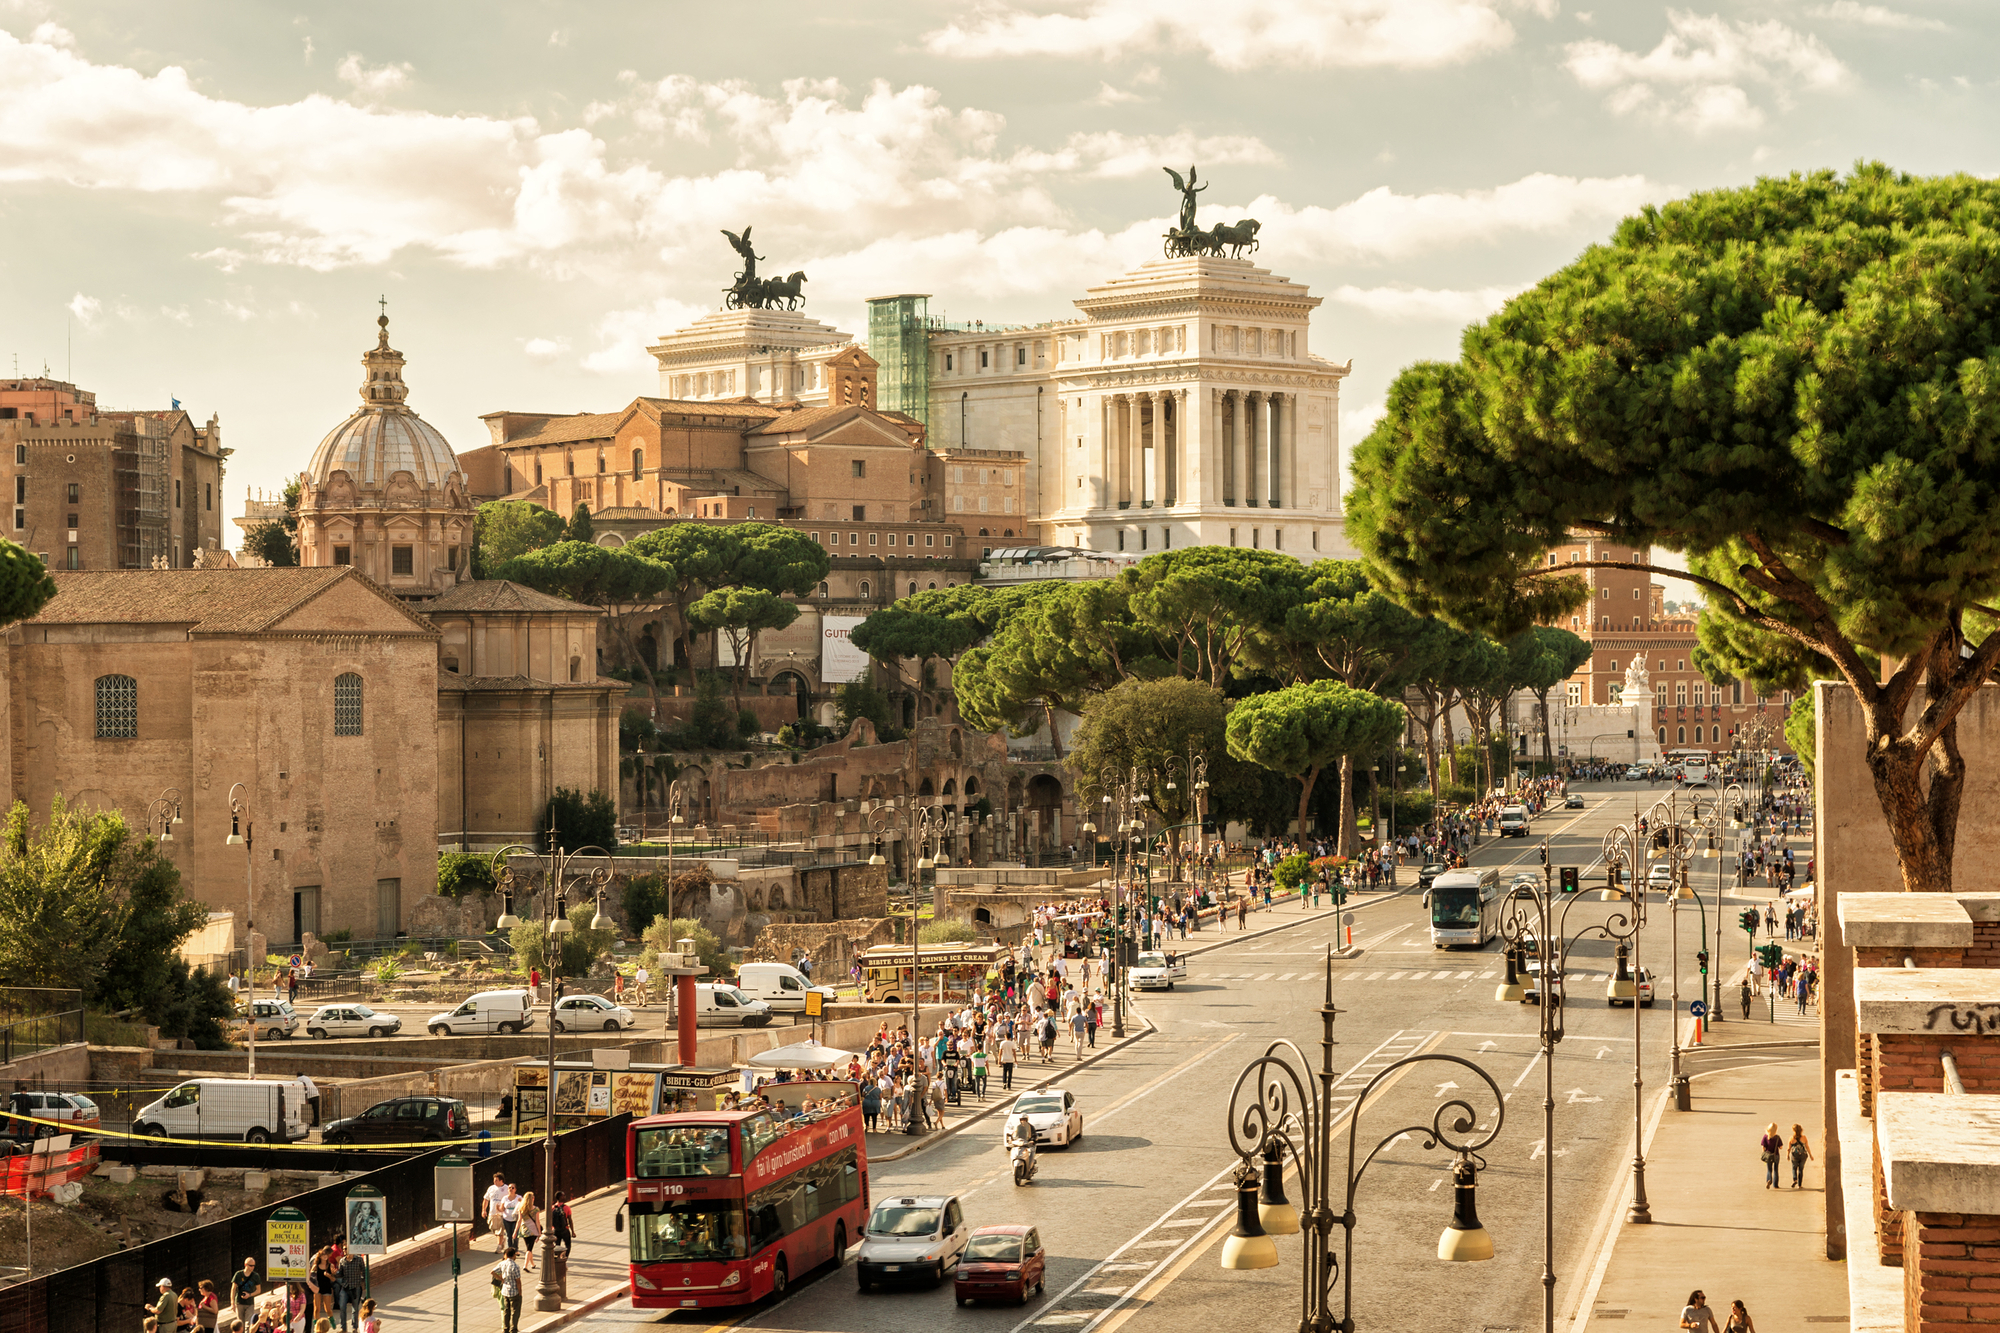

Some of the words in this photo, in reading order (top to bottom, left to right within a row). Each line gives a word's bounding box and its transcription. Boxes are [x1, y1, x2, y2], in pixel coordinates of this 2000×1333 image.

[825, 629, 851, 638] GUTT
[618, 1075, 654, 1086] Panini
[756, 1159, 766, 1177] fai
[766, 1155, 771, 1173] il
[771, 1152, 783, 1175] giro
[783, 1142, 806, 1166] turistico
[806, 1137, 813, 1154] di
[829, 1130, 840, 1144] con
[839, 1123, 849, 1139] 110
[664, 1185, 683, 1195] 110
[683, 1187, 708, 1196] open
